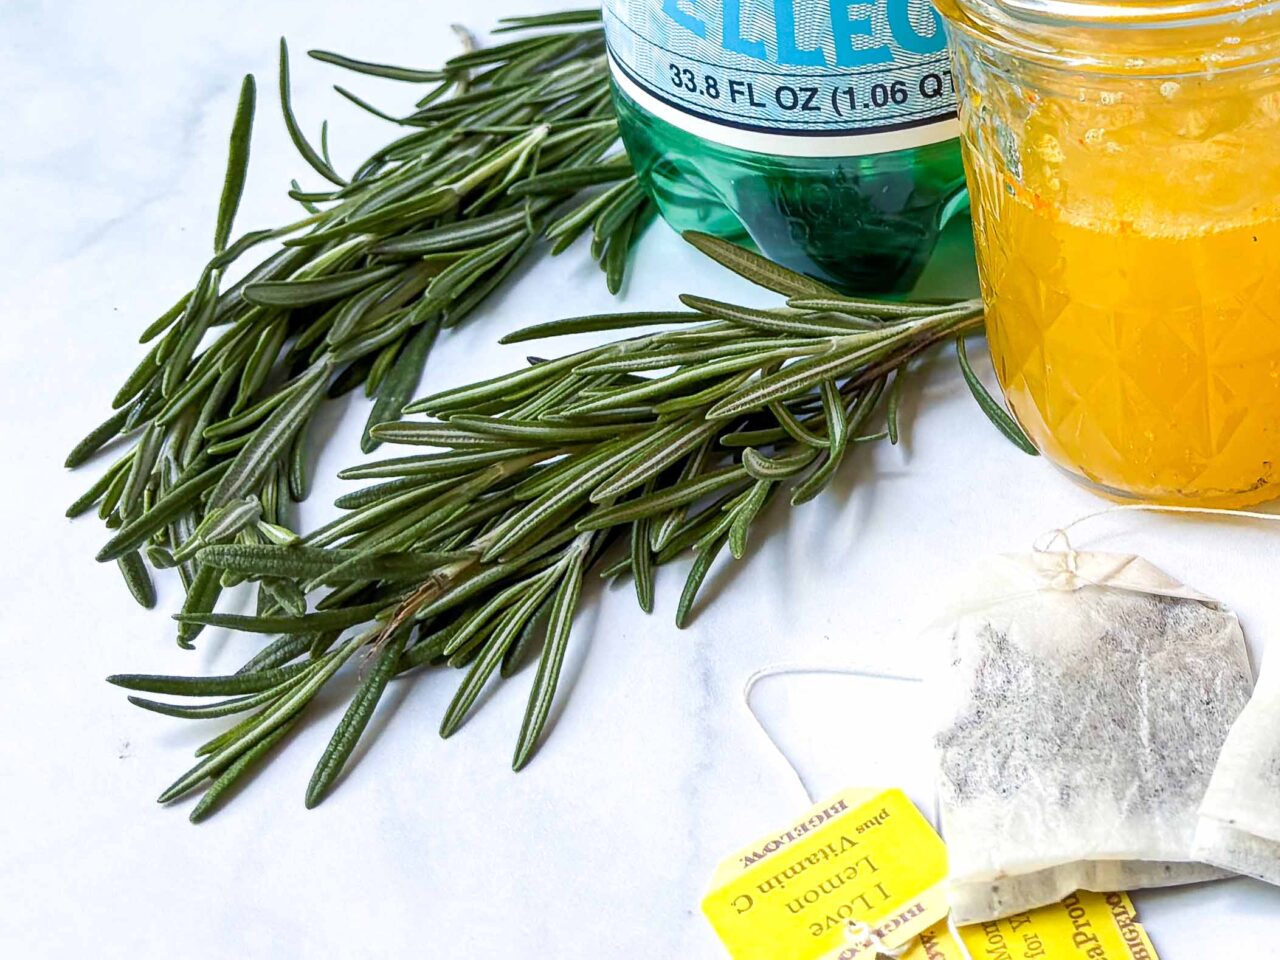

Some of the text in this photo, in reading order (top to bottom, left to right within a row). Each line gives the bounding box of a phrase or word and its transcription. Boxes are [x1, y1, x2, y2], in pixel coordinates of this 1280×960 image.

[669, 63, 721, 100] 33.8
[729, 79, 766, 108] FL
[775, 85, 821, 111] OZ
[831, 81, 909, 117] (1.06
[855, 807, 890, 835] plus
[756, 835, 859, 894] Vitamin
[785, 855, 880, 915] Lemon
[808, 881, 892, 937] I Love
[1104, 890, 1152, 960] BIGELO
[1022, 931, 1045, 960] for
